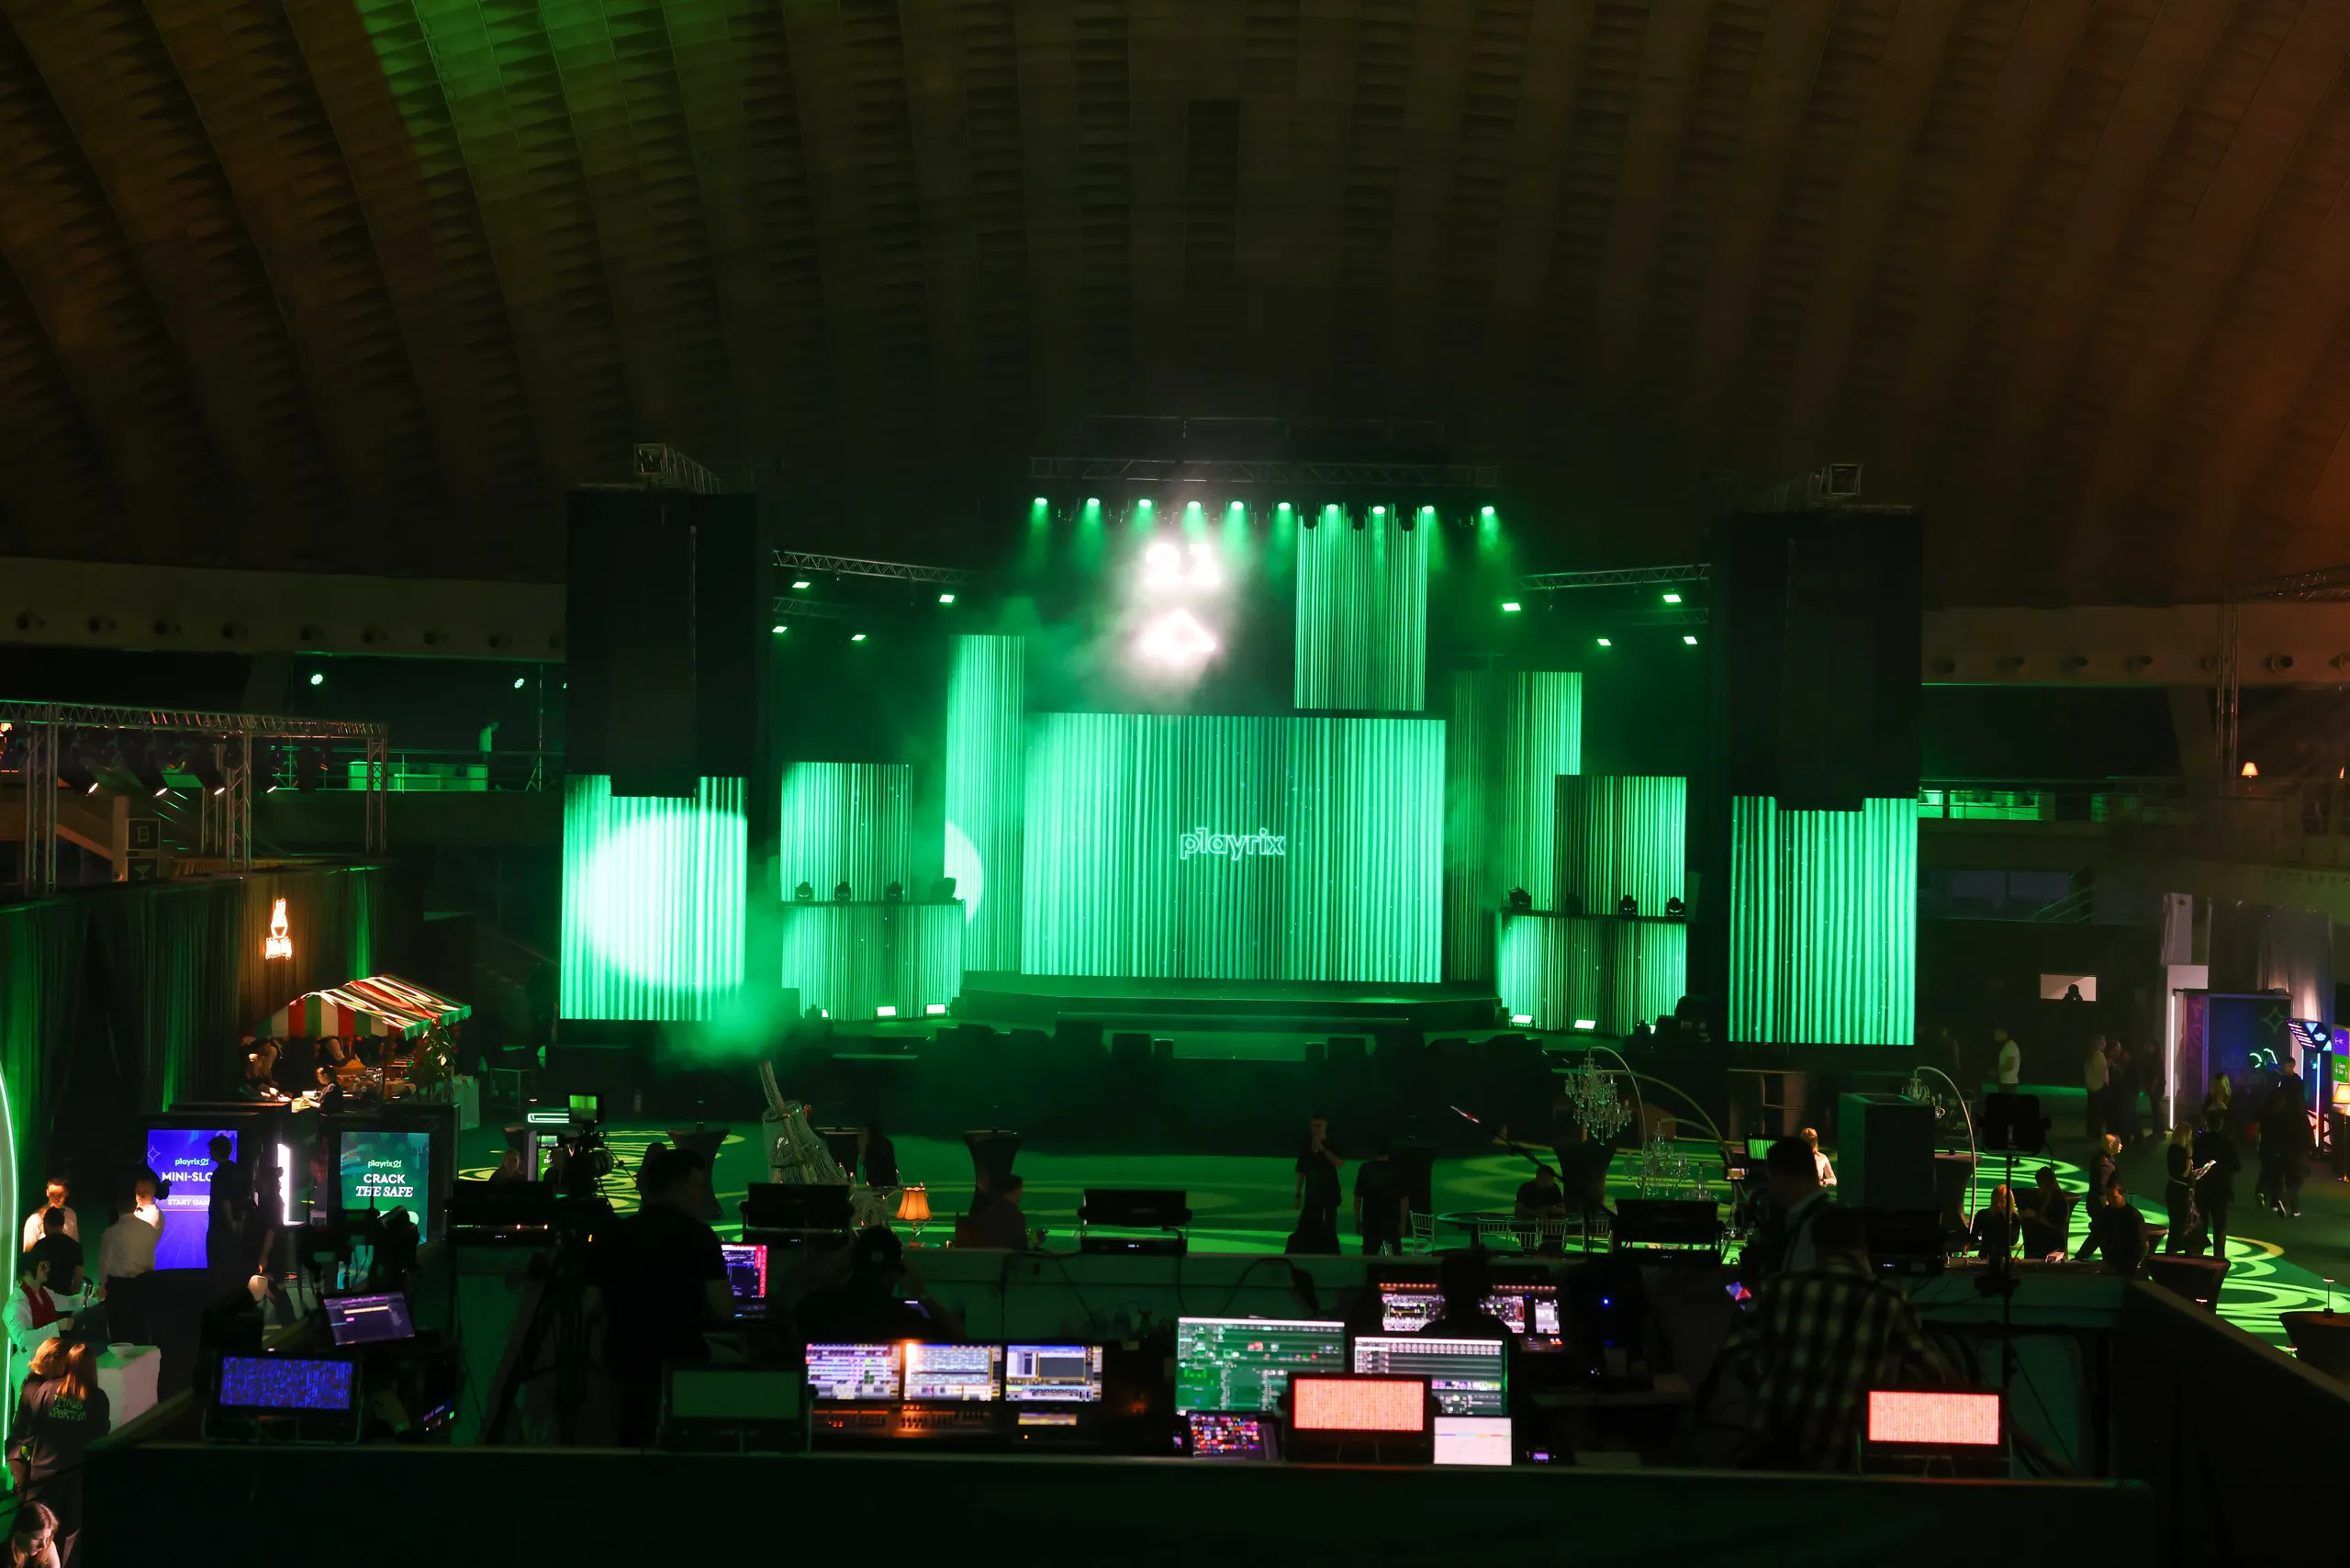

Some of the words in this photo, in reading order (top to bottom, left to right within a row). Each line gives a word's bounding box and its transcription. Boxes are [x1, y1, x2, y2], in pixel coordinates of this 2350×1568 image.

[1180, 827, 1285, 861] playrix
[162, 1171, 213, 1182] MINI-SLO
[363, 1173, 406, 1184] CRACK
[355, 1186, 381, 1197] THE
[383, 1186, 414, 1198] SAFE
[167, 1198, 191, 1206] START
[193, 1198, 210, 1206] GAM
